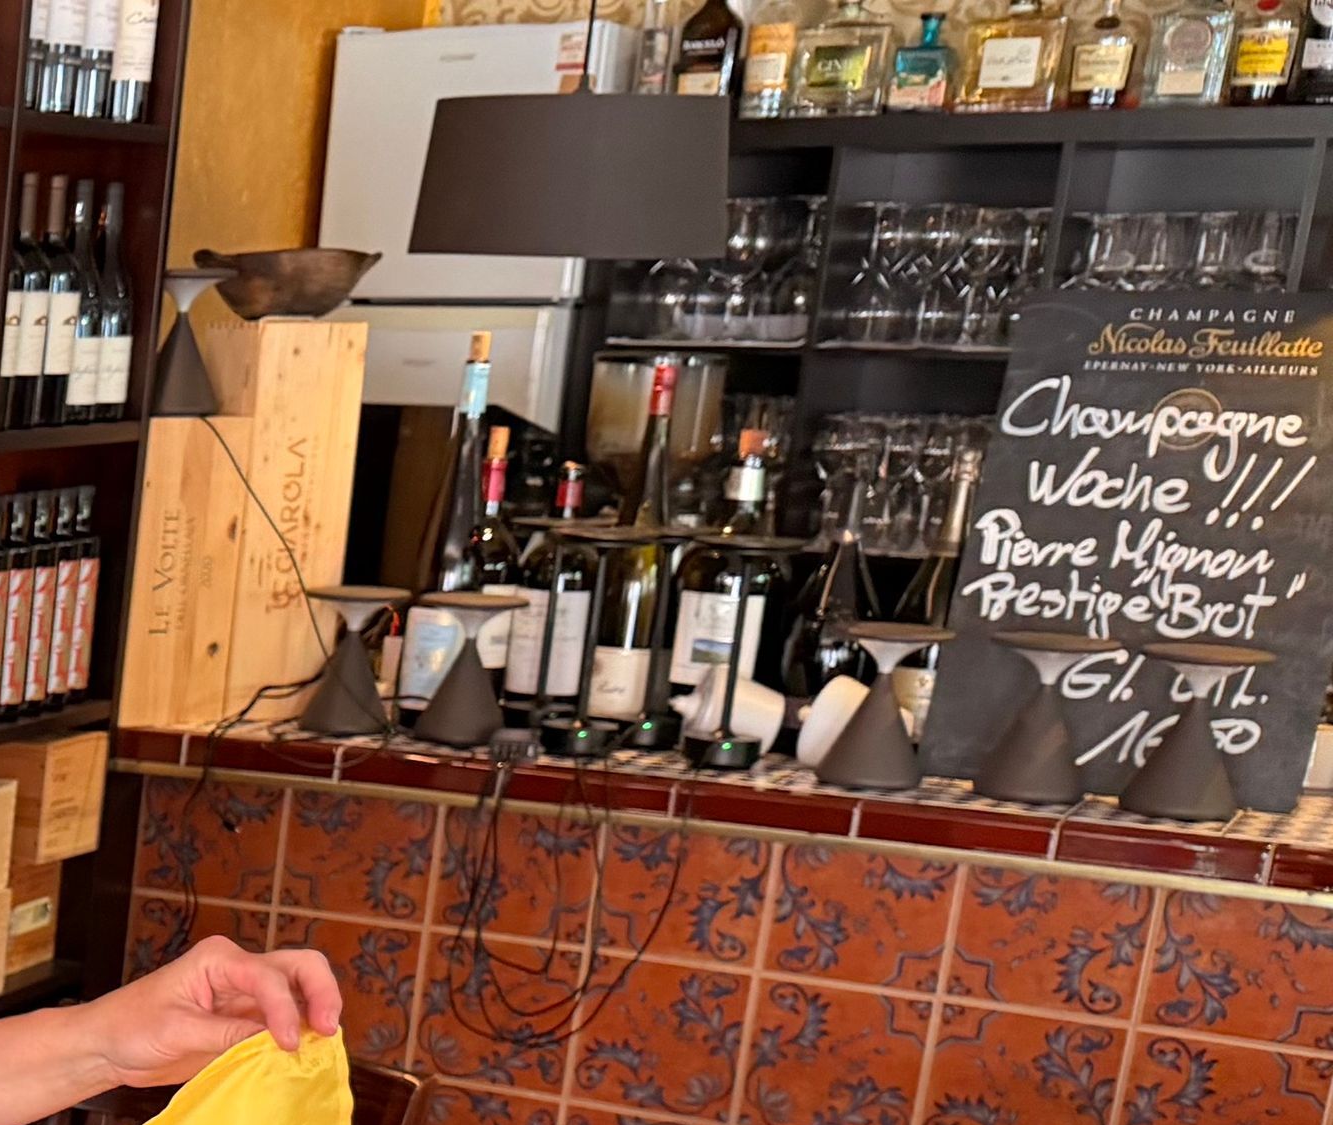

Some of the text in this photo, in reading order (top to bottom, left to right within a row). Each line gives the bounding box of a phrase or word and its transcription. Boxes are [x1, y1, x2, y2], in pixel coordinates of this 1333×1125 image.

[1088, 322, 1323, 359] Nicolas Feuillatte
[1130, 308, 1296, 322] CHAMPAGNE
[1001, 375, 1307, 482] Champagne
[1029, 447, 1191, 513] Woche
[975, 508, 1275, 607] Pierre Mignon
[962, 570, 1153, 639] Prestige
